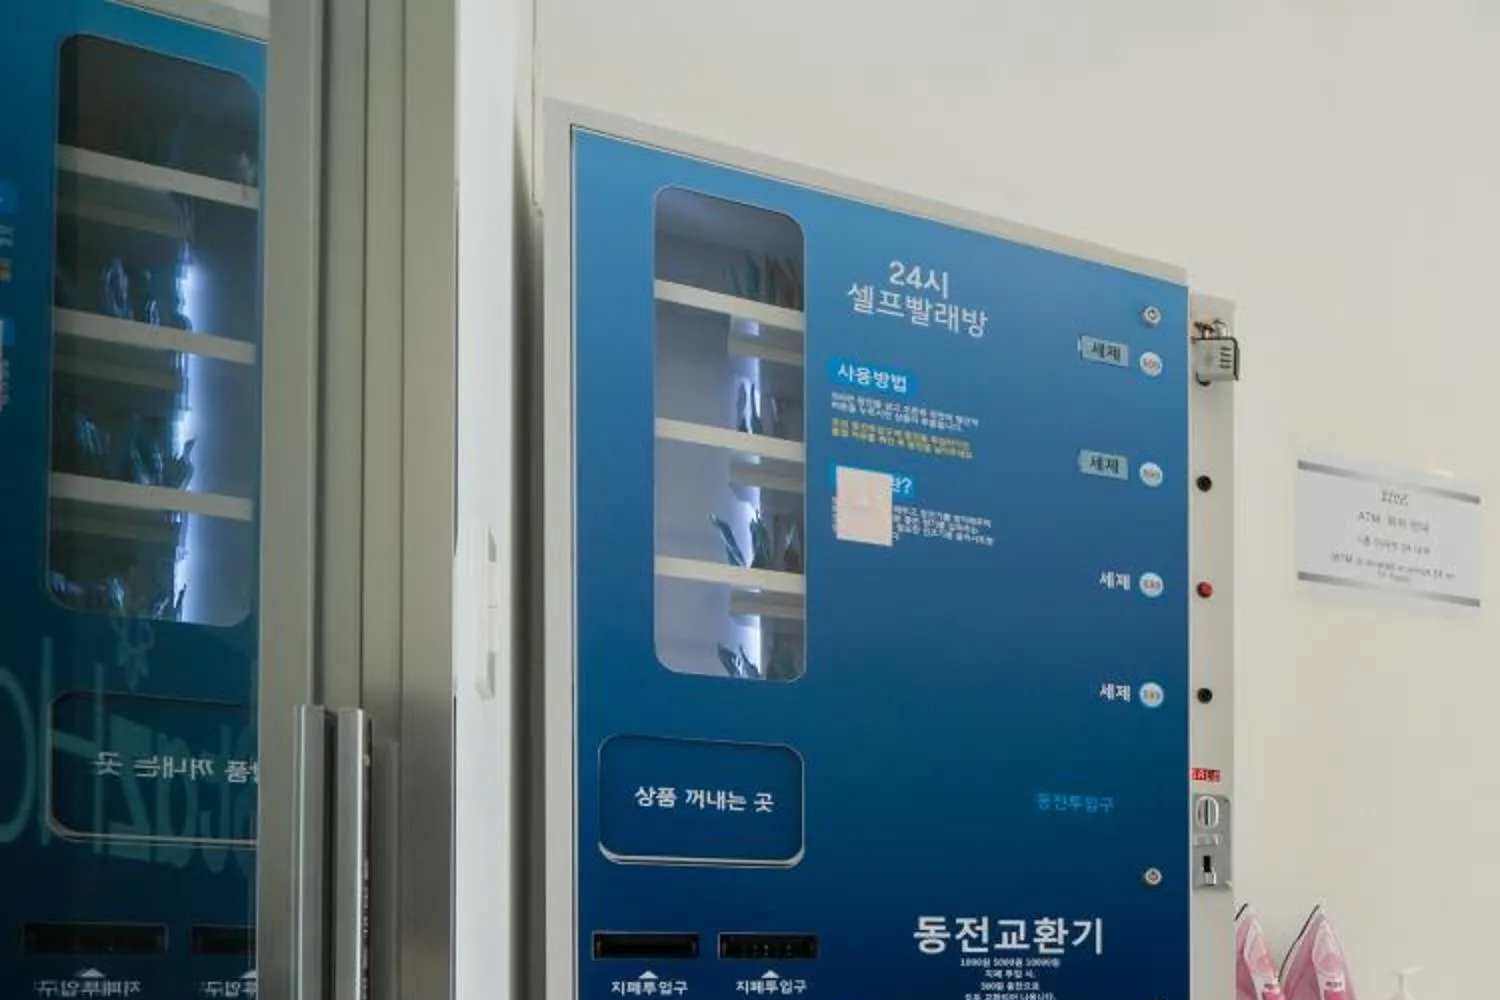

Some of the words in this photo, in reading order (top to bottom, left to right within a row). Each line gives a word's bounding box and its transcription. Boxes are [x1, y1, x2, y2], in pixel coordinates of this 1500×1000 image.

[887, 260, 950, 299] 24시
[847, 283, 988, 338] 셀프빨래방
[837, 364, 907, 393] 사용방법
[1090, 455, 1119, 475] 세제
[1099, 571, 1131, 590] 세제
[1099, 683, 1131, 702] 세제
[634, 785, 677, 808] 상품
[684, 789, 747, 812] 꺼내는
[753, 792, 774, 813] 곳
[1036, 793, 1114, 813] 동전투입구
[913, 916, 1103, 955] 동전교환기
[611, 980, 689, 996] 지폐투입구
[735, 979, 808, 996] 지폐투입구
